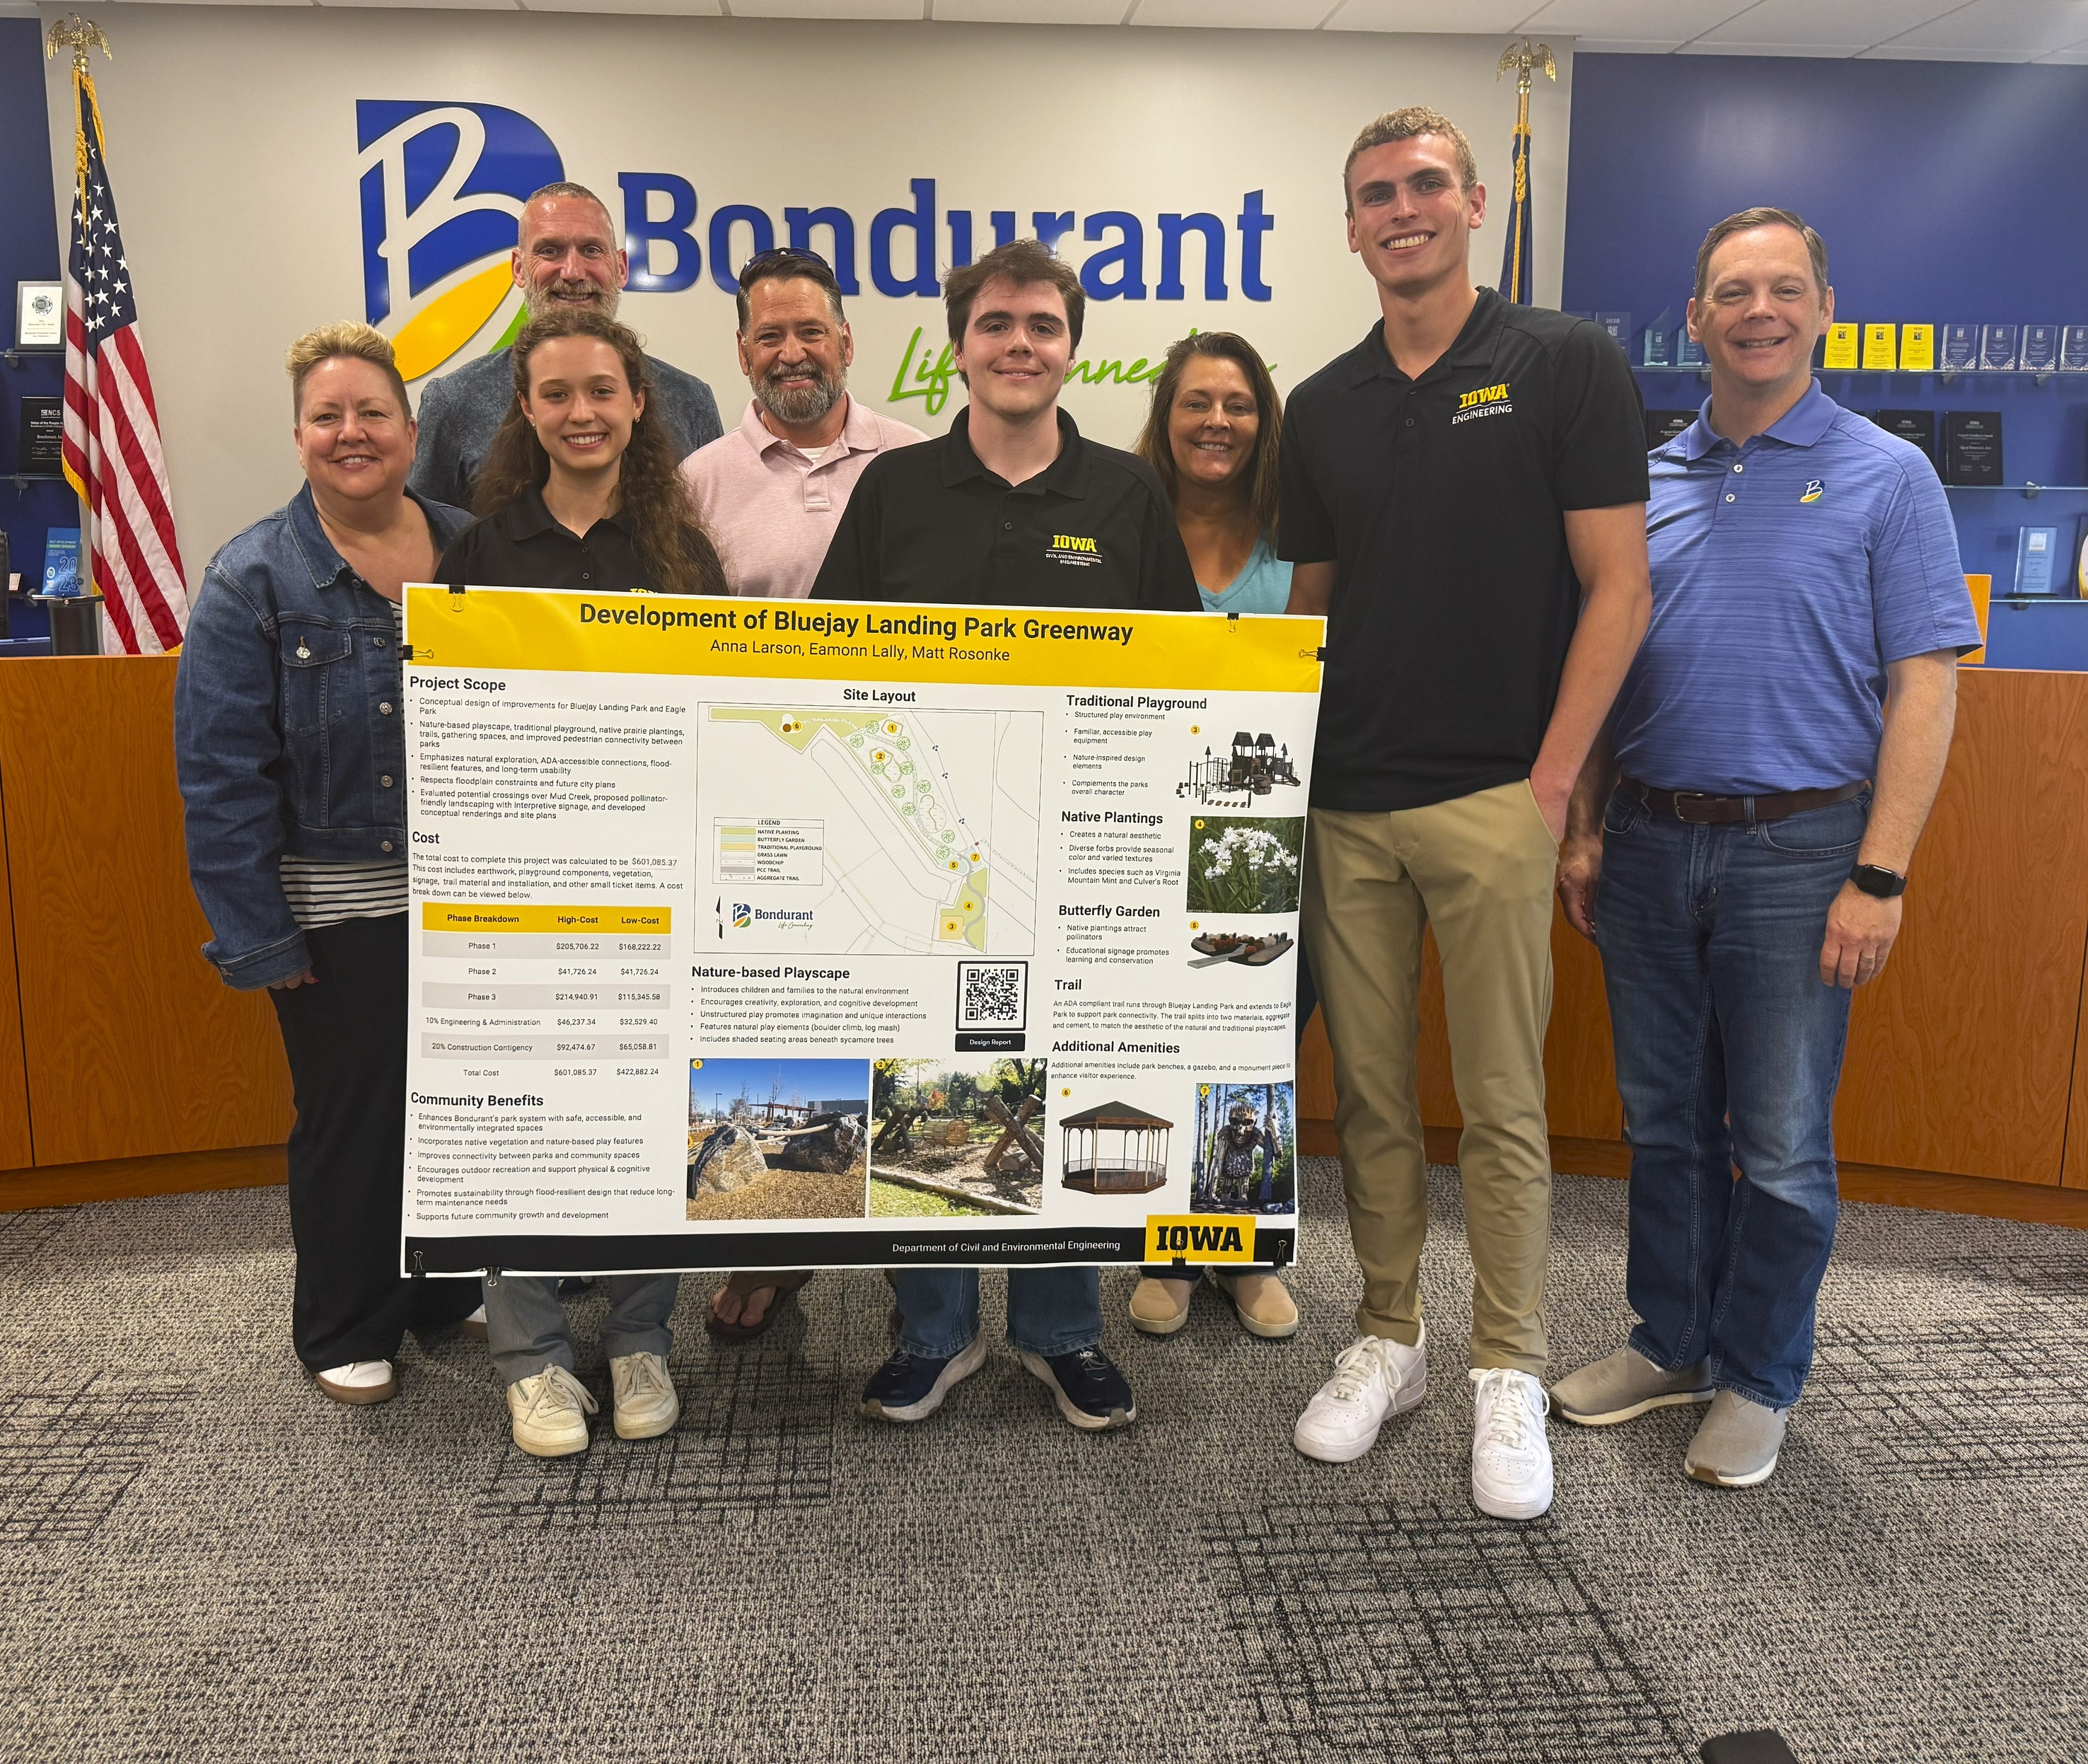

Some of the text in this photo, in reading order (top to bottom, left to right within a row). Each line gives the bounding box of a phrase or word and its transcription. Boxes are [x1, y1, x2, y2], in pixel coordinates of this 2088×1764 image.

[888, 326, 958, 416] Lif
[1458, 383, 1508, 409] IOWA
[1452, 405, 1513, 425] ENGINEERING
[1052, 535, 1097, 552] IOWA
[581, 603, 1133, 646] Development of Bluejay Landing Park Greenway
[710, 639, 1009, 661] Anna Larson, Eamonn Lally, Matt Rosonke
[410, 676, 506, 693] Project Scope
[844, 689, 915, 704] Site Layout
[1067, 695, 1207, 711] Traditional Playground
[421, 776, 453, 784] Respects
[456, 777, 493, 787] floodplain
[581, 781, 593, 789] city
[596, 781, 615, 789] plans
[1062, 811, 1163, 827] Native Plantings
[412, 832, 440, 845] Cost
[447, 913, 659, 925] Phase Breakdown High-Cost Low-Cost
[755, 909, 813, 921] Bondurant
[1060, 905, 1159, 919] Butterfly Garden
[556, 942, 600, 951] $205,706.22
[618, 943, 661, 951] $168,222.22
[557, 968, 597, 976] $41,726.24
[620, 968, 659, 976] $41,726.24
[692, 966, 850, 982] Nature-based Playscape
[1055, 979, 1082, 991] Trail
[555, 993, 598, 1002] $214,940.91
[441, 1018, 480, 1028] Engineering
[557, 1019, 596, 1027] $46,237.34
[620, 1018, 658, 1026] $32,529.40
[494, 1044, 533, 1053] Contigency
[557, 1043, 596, 1052] $92,474.67
[619, 1043, 656, 1051] $65,058.81
[1052, 1040, 1180, 1053] Additional Amenities
[554, 1068, 597, 1077] $601,085.37
[616, 1067, 659, 1076] $422,882.24
[411, 1092, 543, 1110] Community Benefits
[418, 1151, 450, 1160] Improves
[453, 1152, 497, 1161] connectivity
[533, 1152, 552, 1161] parks
[571, 1152, 611, 1161] community
[1156, 1225, 1243, 1252] IOWA
[893, 1240, 1120, 1254] Department of Civil and Environmental Engineering
